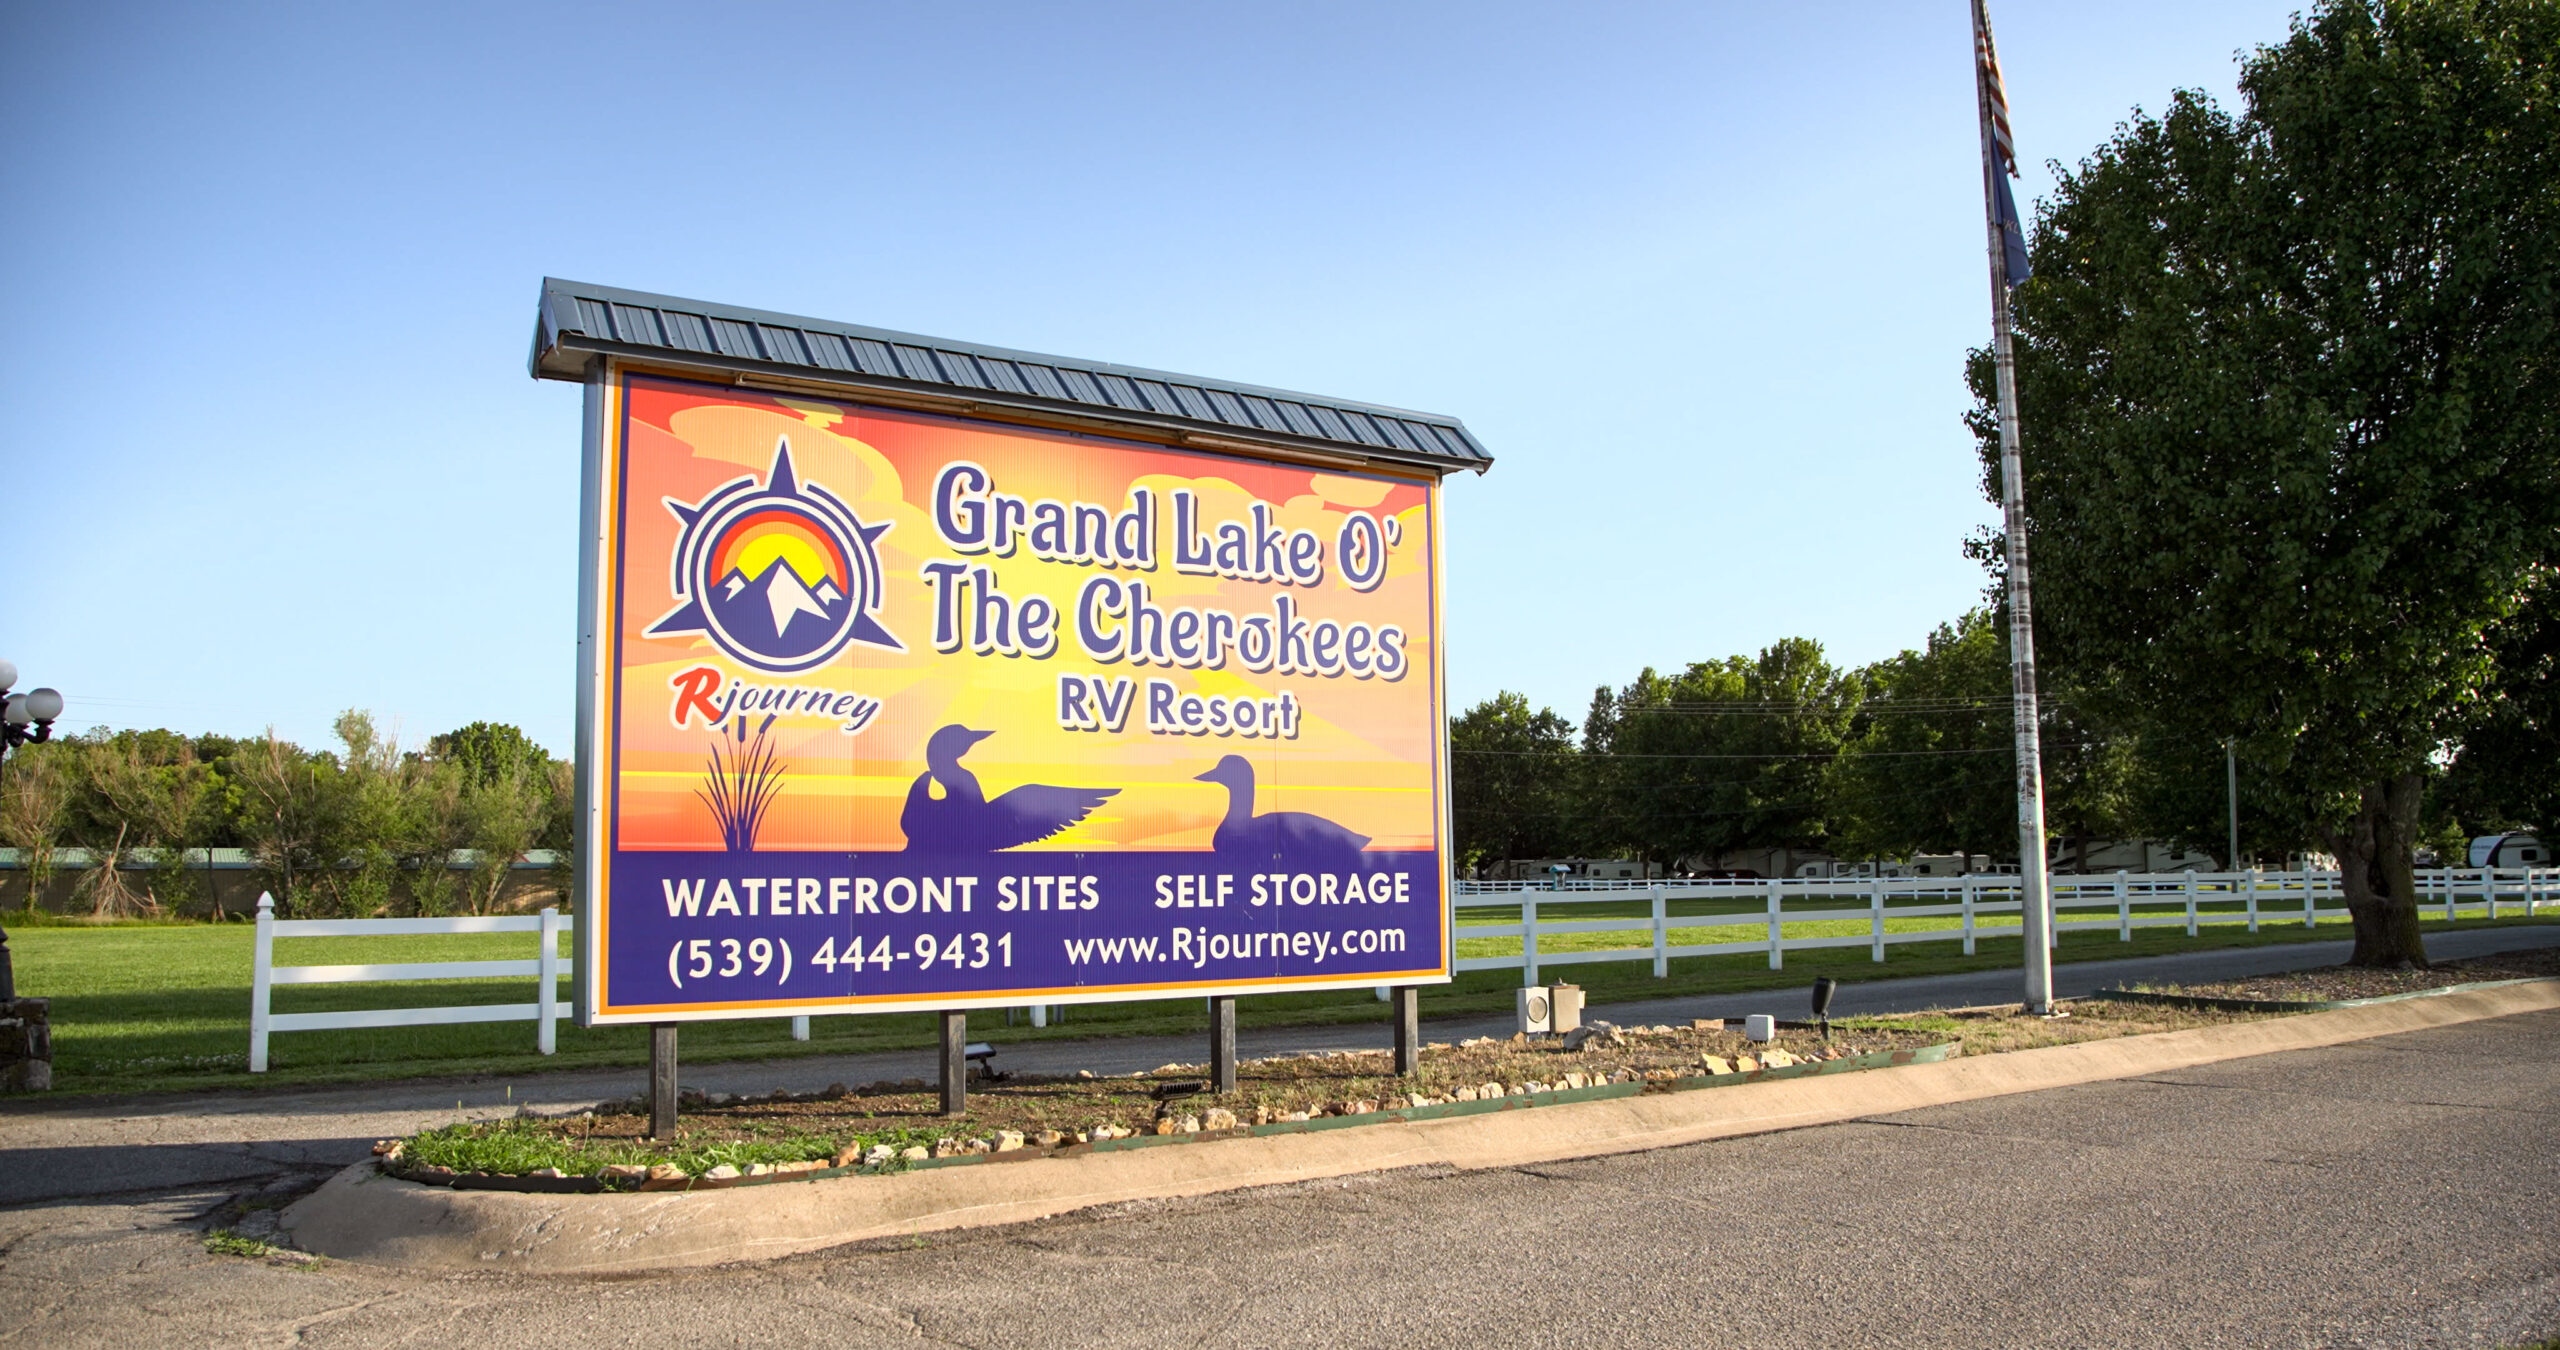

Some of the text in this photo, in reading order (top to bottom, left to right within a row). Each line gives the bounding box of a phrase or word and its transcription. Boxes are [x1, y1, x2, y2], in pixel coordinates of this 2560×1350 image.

[935, 465, 1397, 587] Grand Lake O'
[924, 563, 1402, 674] The Cherokees
[1062, 677, 1294, 731] RV Resort
[662, 875, 1099, 917] WATERFRONT SITES
[1155, 872, 1410, 908] SELF STORAGE
[668, 932, 1013, 989] (539) 444-9431
[1064, 926, 1406, 969] www.Rjourney.com
